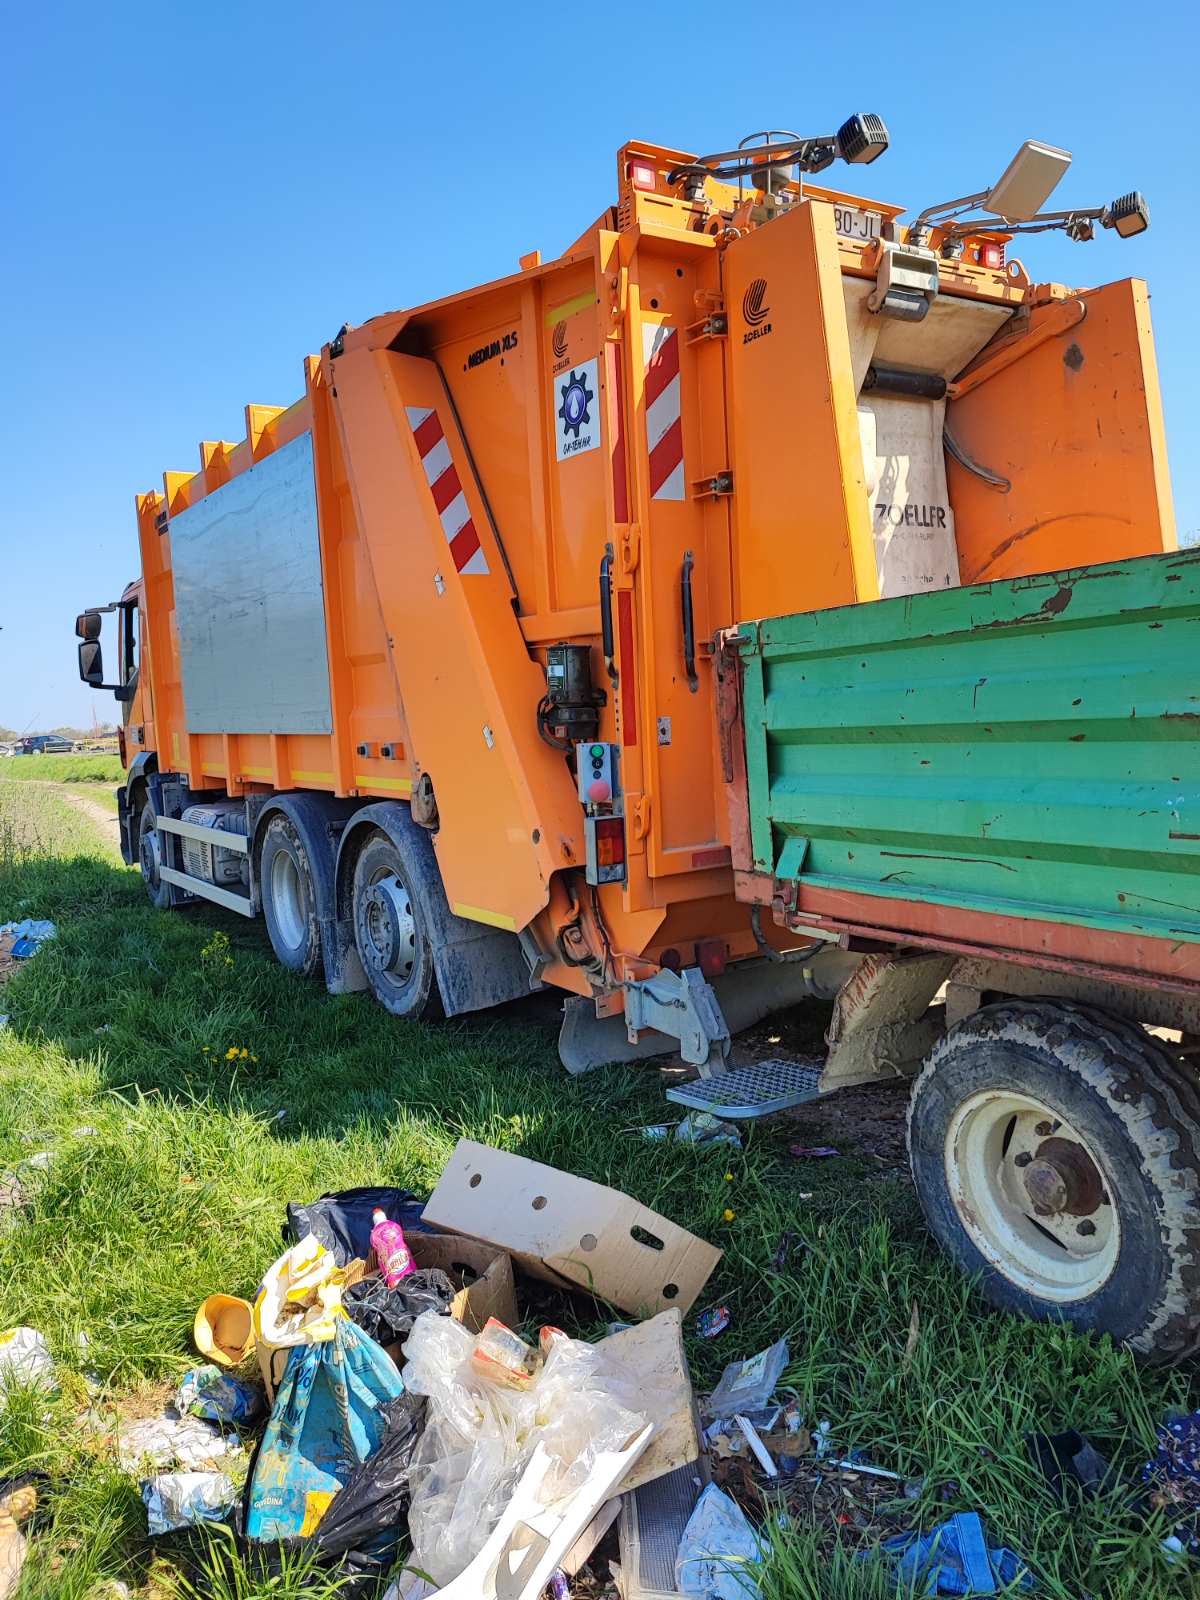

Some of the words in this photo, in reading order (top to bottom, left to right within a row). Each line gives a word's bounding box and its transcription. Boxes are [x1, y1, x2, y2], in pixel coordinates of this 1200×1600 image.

[743, 323, 772, 345] ZOELLER
[467, 339, 501, 370] MEDIUM
[502, 330, 518, 354] XLS
